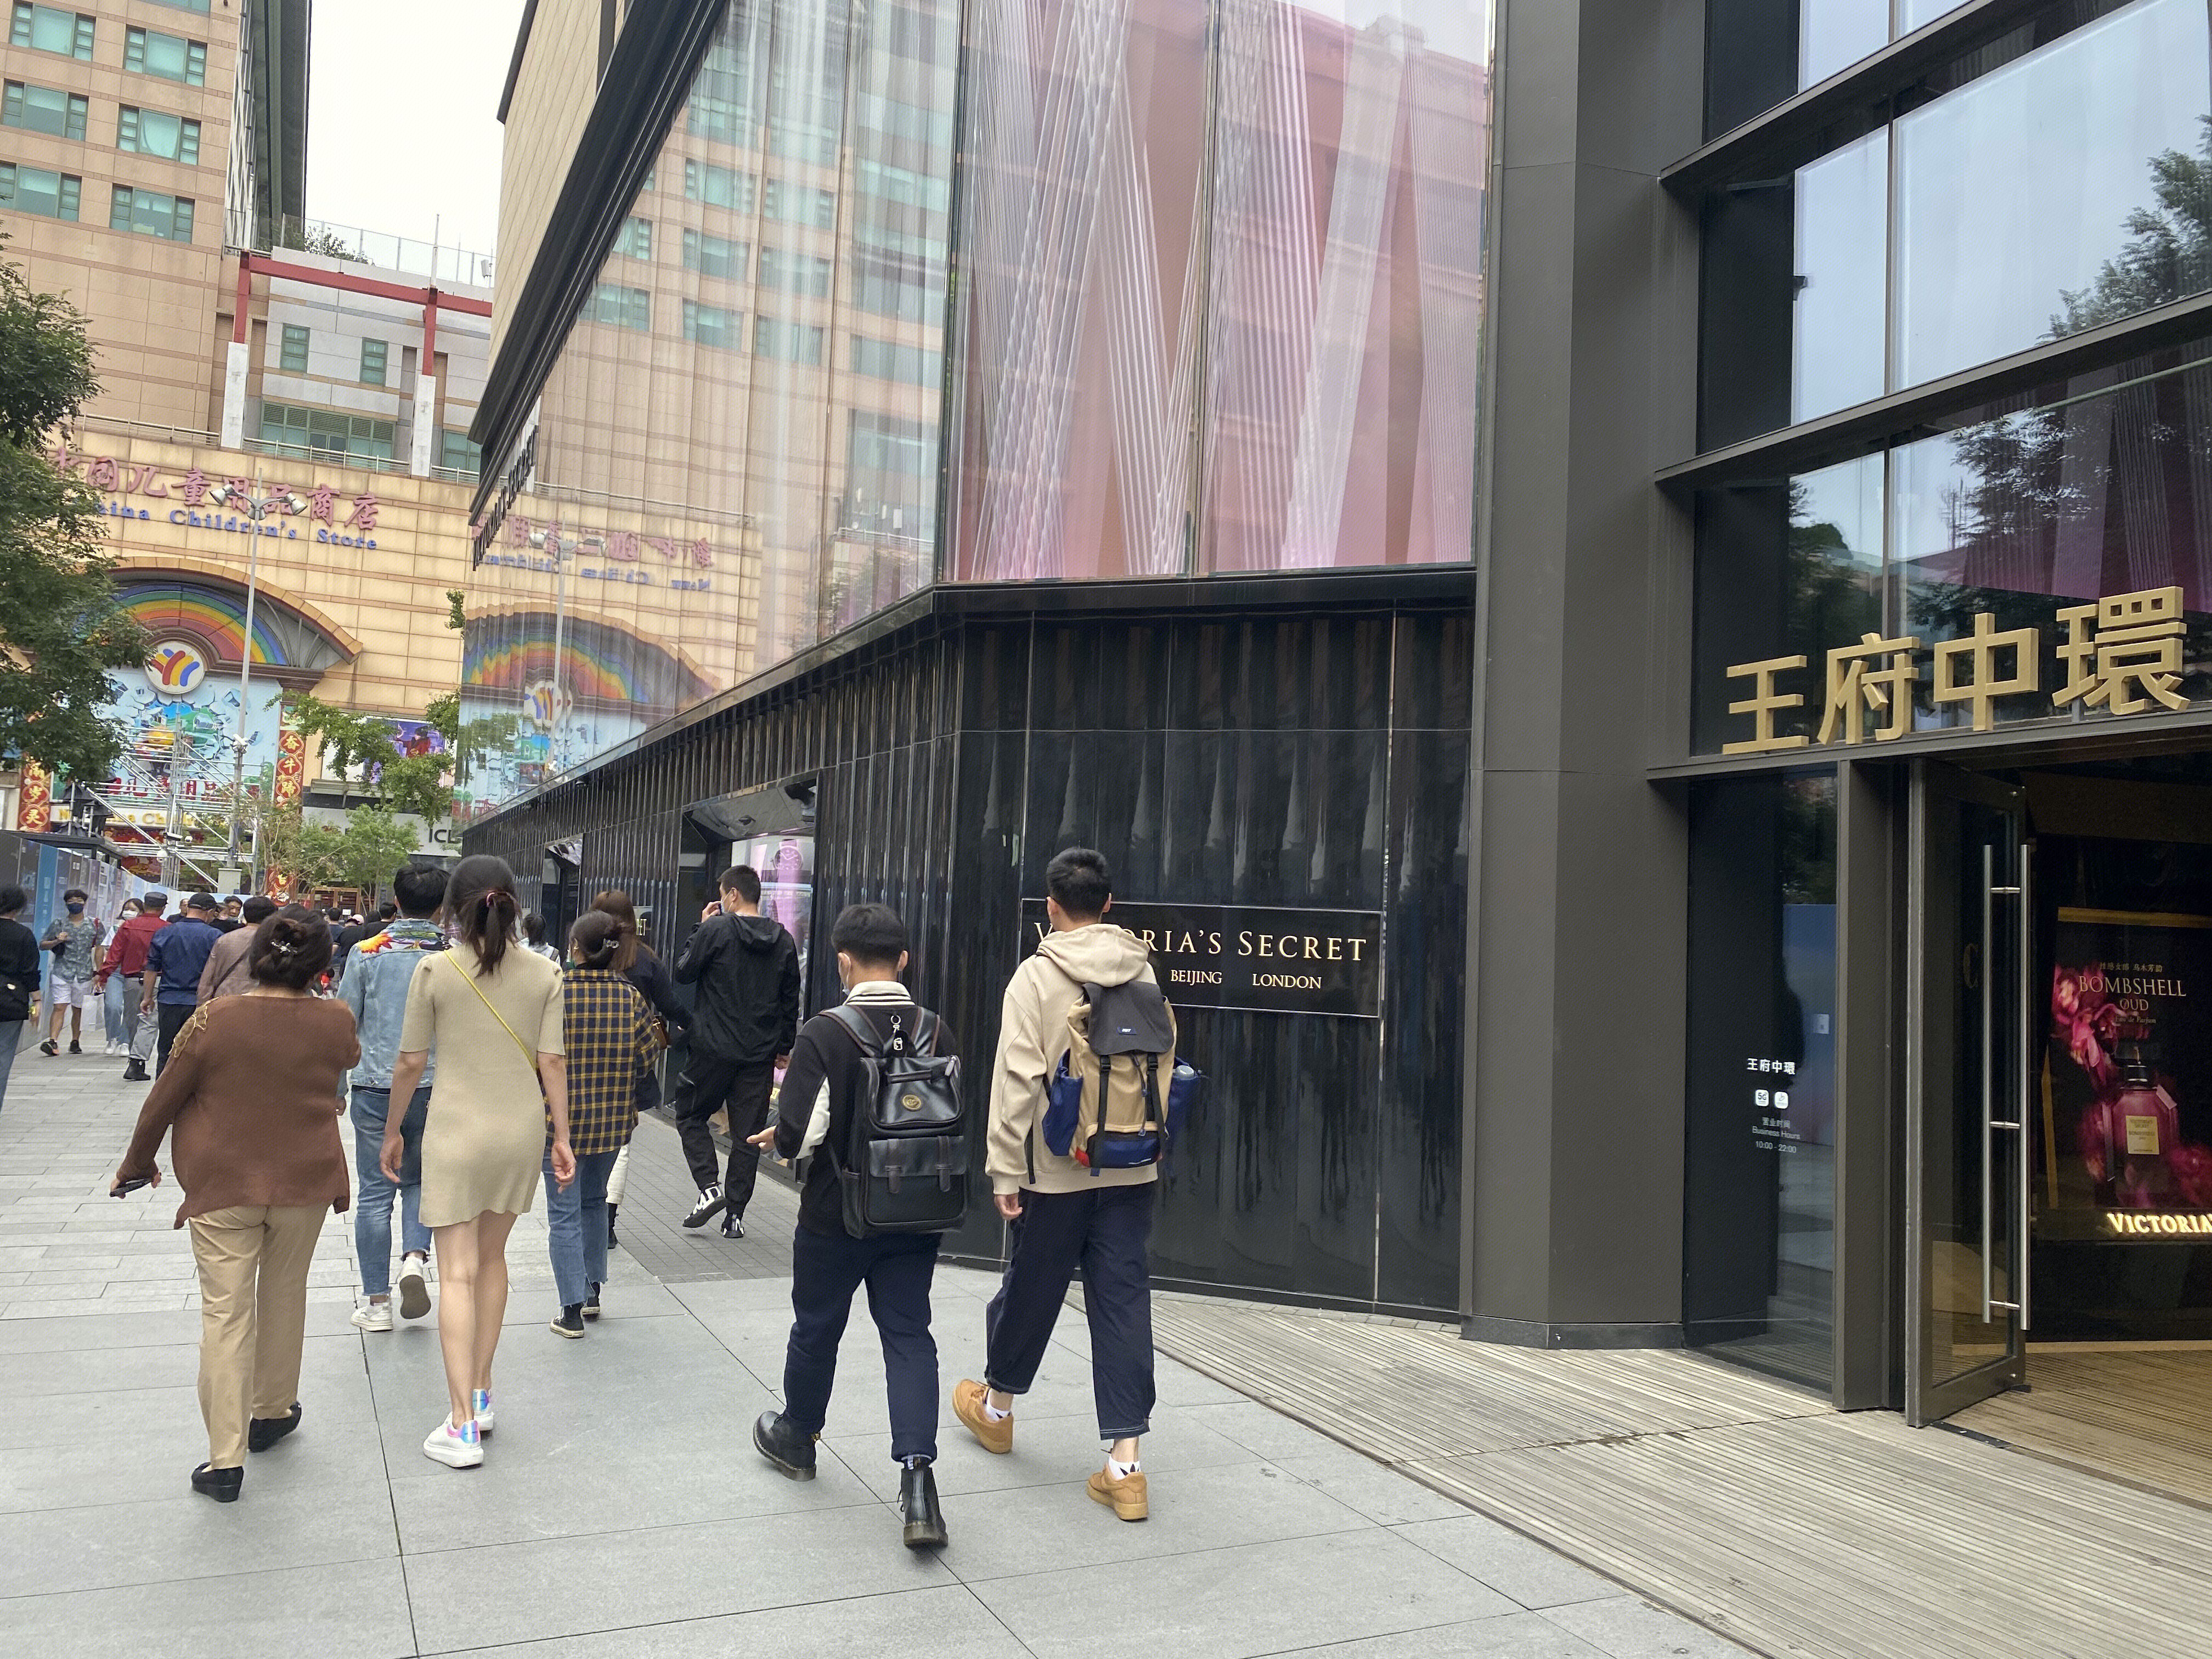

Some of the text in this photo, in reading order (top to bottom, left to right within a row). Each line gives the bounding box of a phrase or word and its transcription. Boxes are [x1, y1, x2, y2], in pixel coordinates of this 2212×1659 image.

[95, 501, 377, 549] ina Children's Store
[1722, 586, 2191, 755] 王府中環
[1034, 922, 1367, 961] VRIA'S SECRET
[1170, 969, 1222, 985] BEIJING
[1252, 973, 1322, 989] LONDON
[2079, 976, 2186, 996] BOMBSHELL
[2120, 998, 2149, 1011] OUD
[1747, 1058, 1795, 1075] 王府中環
[1762, 1117, 1791, 1129] 营业时间
[1752, 1126, 1800, 1139] Business Hours
[1756, 1141, 1773, 1149] 10:00
[1778, 1144, 1797, 1153] 22:00
